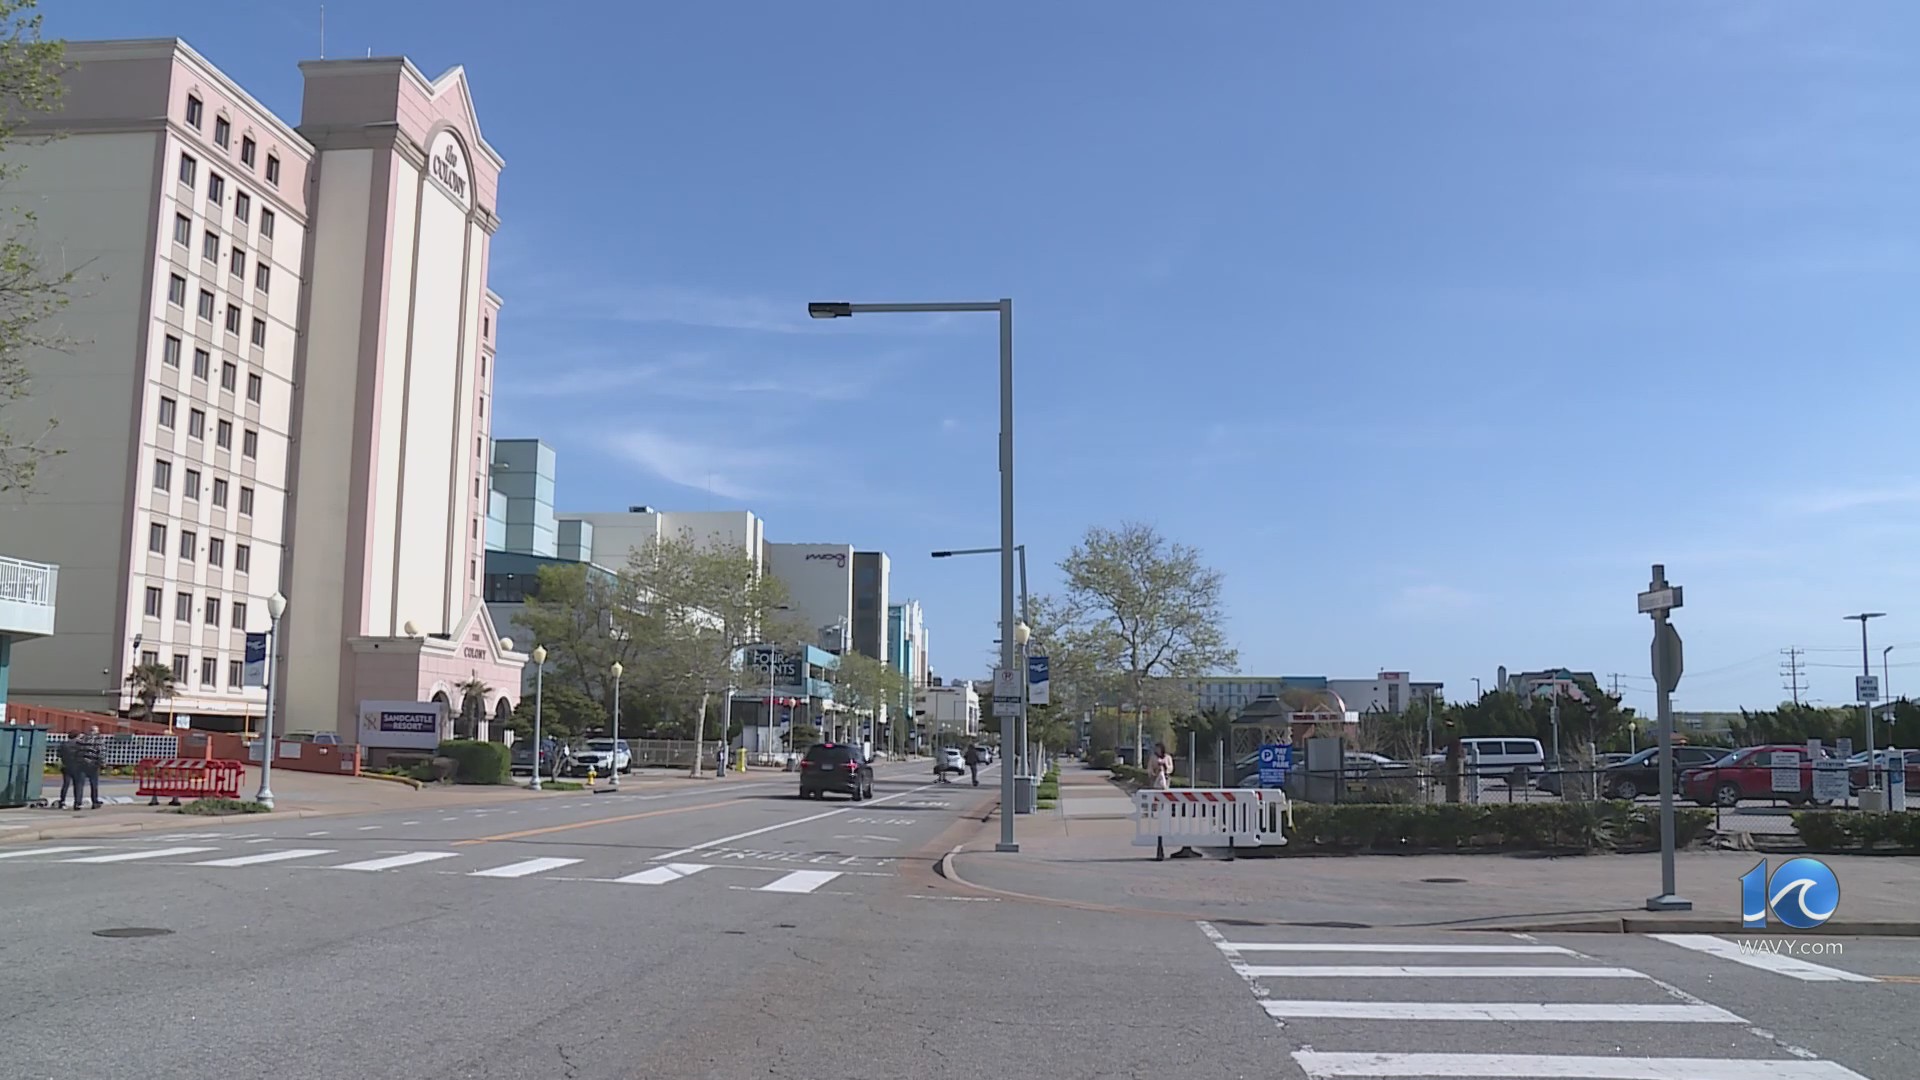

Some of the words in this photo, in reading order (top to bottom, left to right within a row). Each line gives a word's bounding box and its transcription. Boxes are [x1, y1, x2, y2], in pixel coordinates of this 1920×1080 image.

[445, 145, 457, 168] the
[433, 154, 466, 199] COLONY
[464, 647, 486, 660] COLONY
[753, 650, 785, 664] FOUR
[752, 664, 795, 675] POINTS
[383, 713, 433, 723] SANDCASTLE
[393, 722, 423, 730] RESORT
